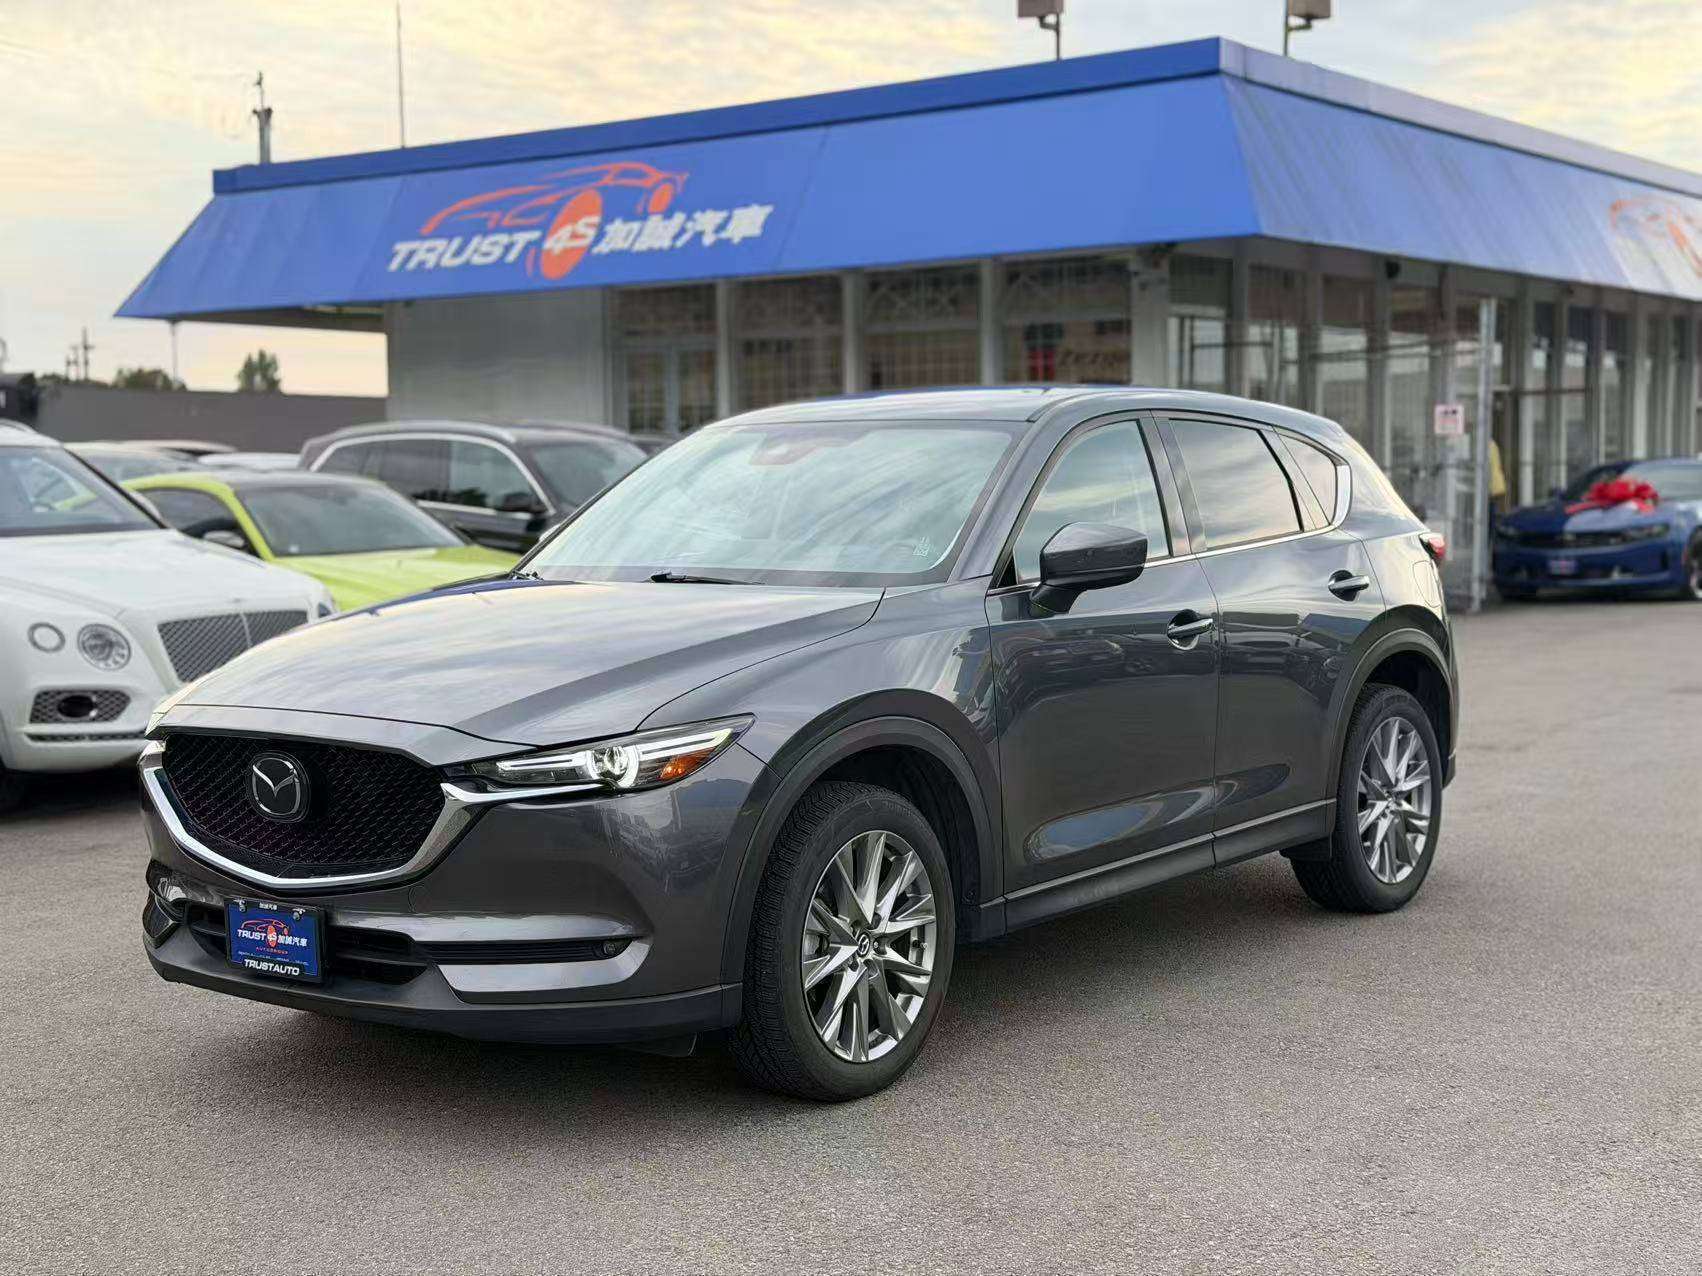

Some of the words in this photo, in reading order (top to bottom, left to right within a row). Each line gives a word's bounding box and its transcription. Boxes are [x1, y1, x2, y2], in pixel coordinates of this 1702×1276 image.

[388, 230, 541, 271] TRUST
[543, 216, 601, 254] 4S
[237, 929, 266, 941] TRUST
[244, 959, 299, 976] TRUSTAUTO
